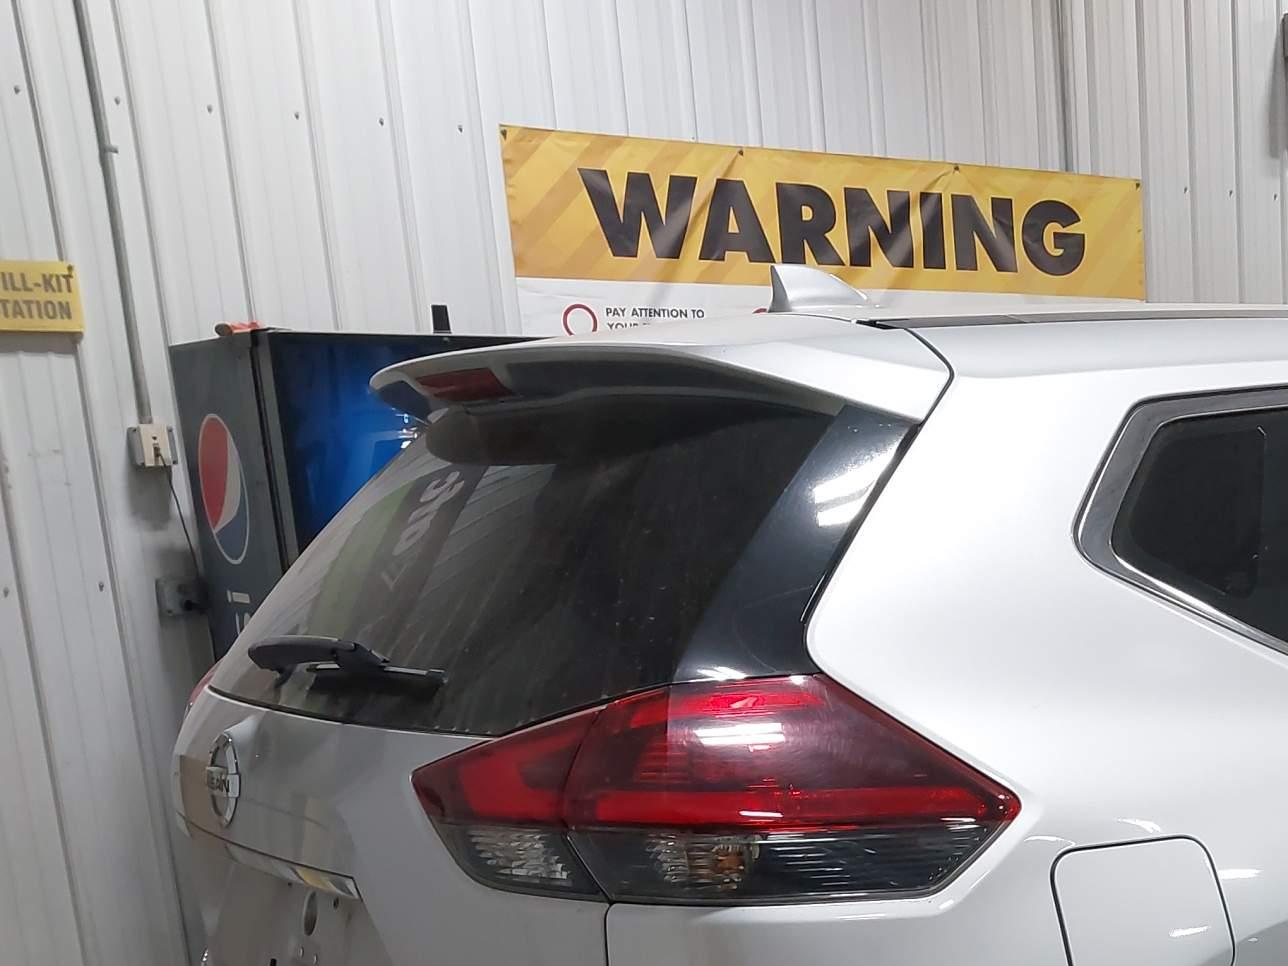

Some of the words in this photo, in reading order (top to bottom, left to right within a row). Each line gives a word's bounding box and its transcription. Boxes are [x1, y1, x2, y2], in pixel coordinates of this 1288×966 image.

[577, 167, 1086, 277] WARNING
[605, 307, 626, 318] PAY
[631, 307, 688, 319] ATTENTION
[691, 309, 705, 319] TO
